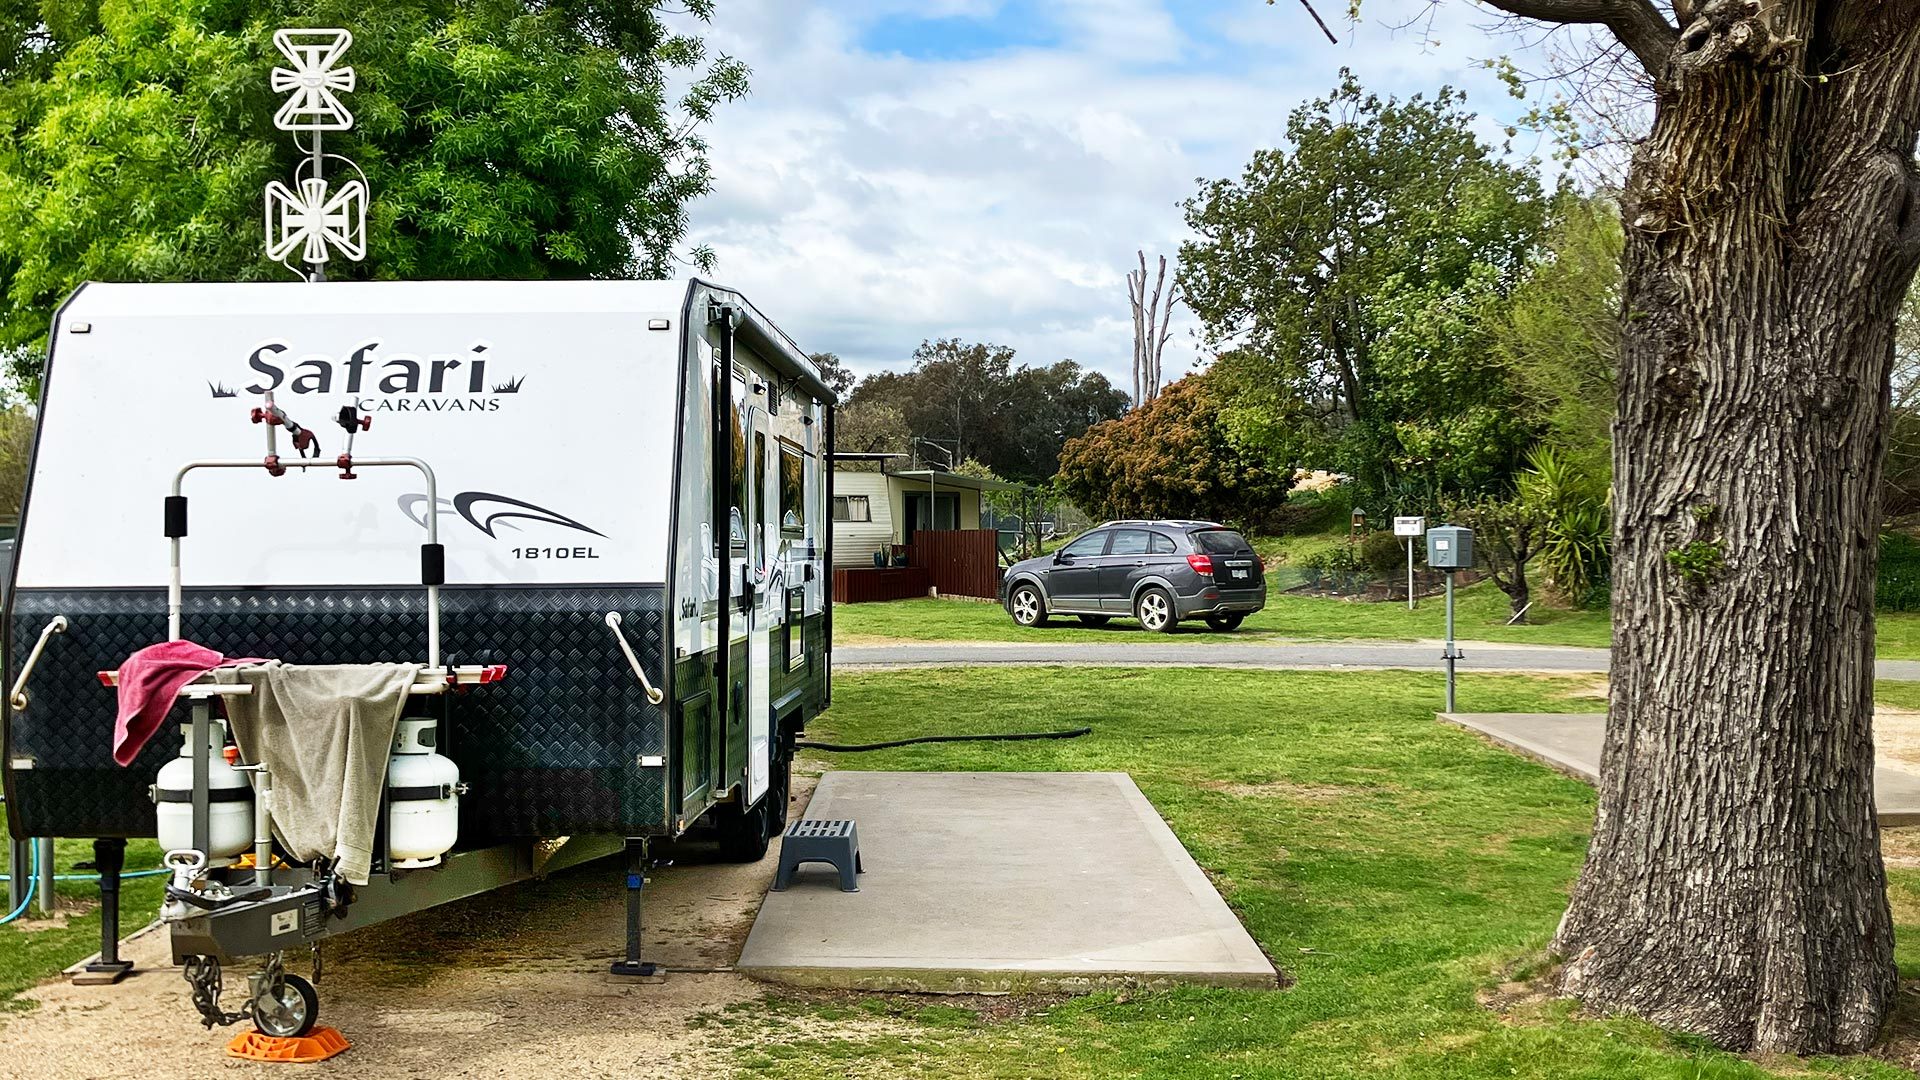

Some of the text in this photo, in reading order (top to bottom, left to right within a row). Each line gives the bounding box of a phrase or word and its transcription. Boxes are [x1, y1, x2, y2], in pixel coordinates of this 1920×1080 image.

[244, 342, 488, 395] Safari
[358, 397, 500, 412] CARAVANS
[511, 546, 600, 560] 1810EL
